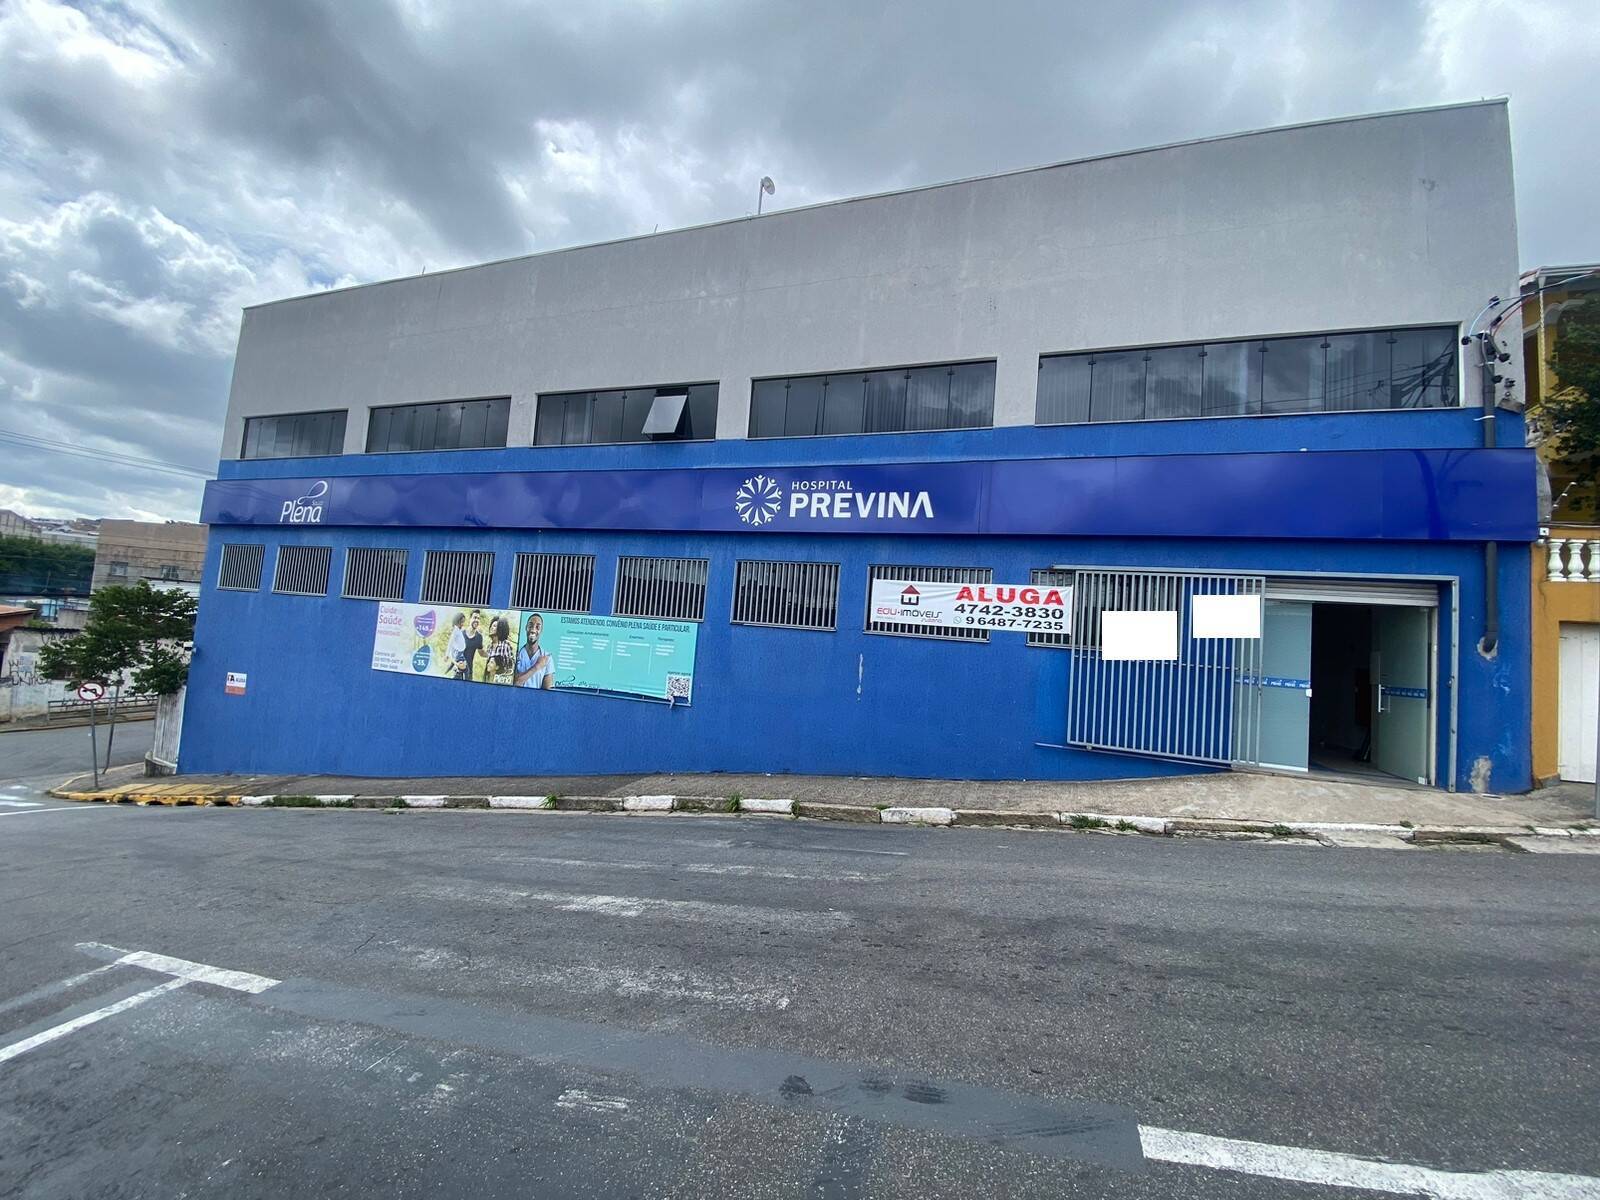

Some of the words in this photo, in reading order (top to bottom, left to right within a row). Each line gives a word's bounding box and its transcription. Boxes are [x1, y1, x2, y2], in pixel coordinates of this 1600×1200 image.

[792, 480, 853, 490] HOSPITAL
[280, 500, 322, 522] Plena
[789, 491, 934, 518] PREVINA
[956, 586, 1064, 605] ALUGA
[954, 603, 1064, 619] 4742-3830
[379, 614, 402, 625] Saúde
[560, 616, 580, 625] ESTAMOS
[629, 621, 642, 629] PLENA
[977, 617, 1063, 630] 6487-7235
